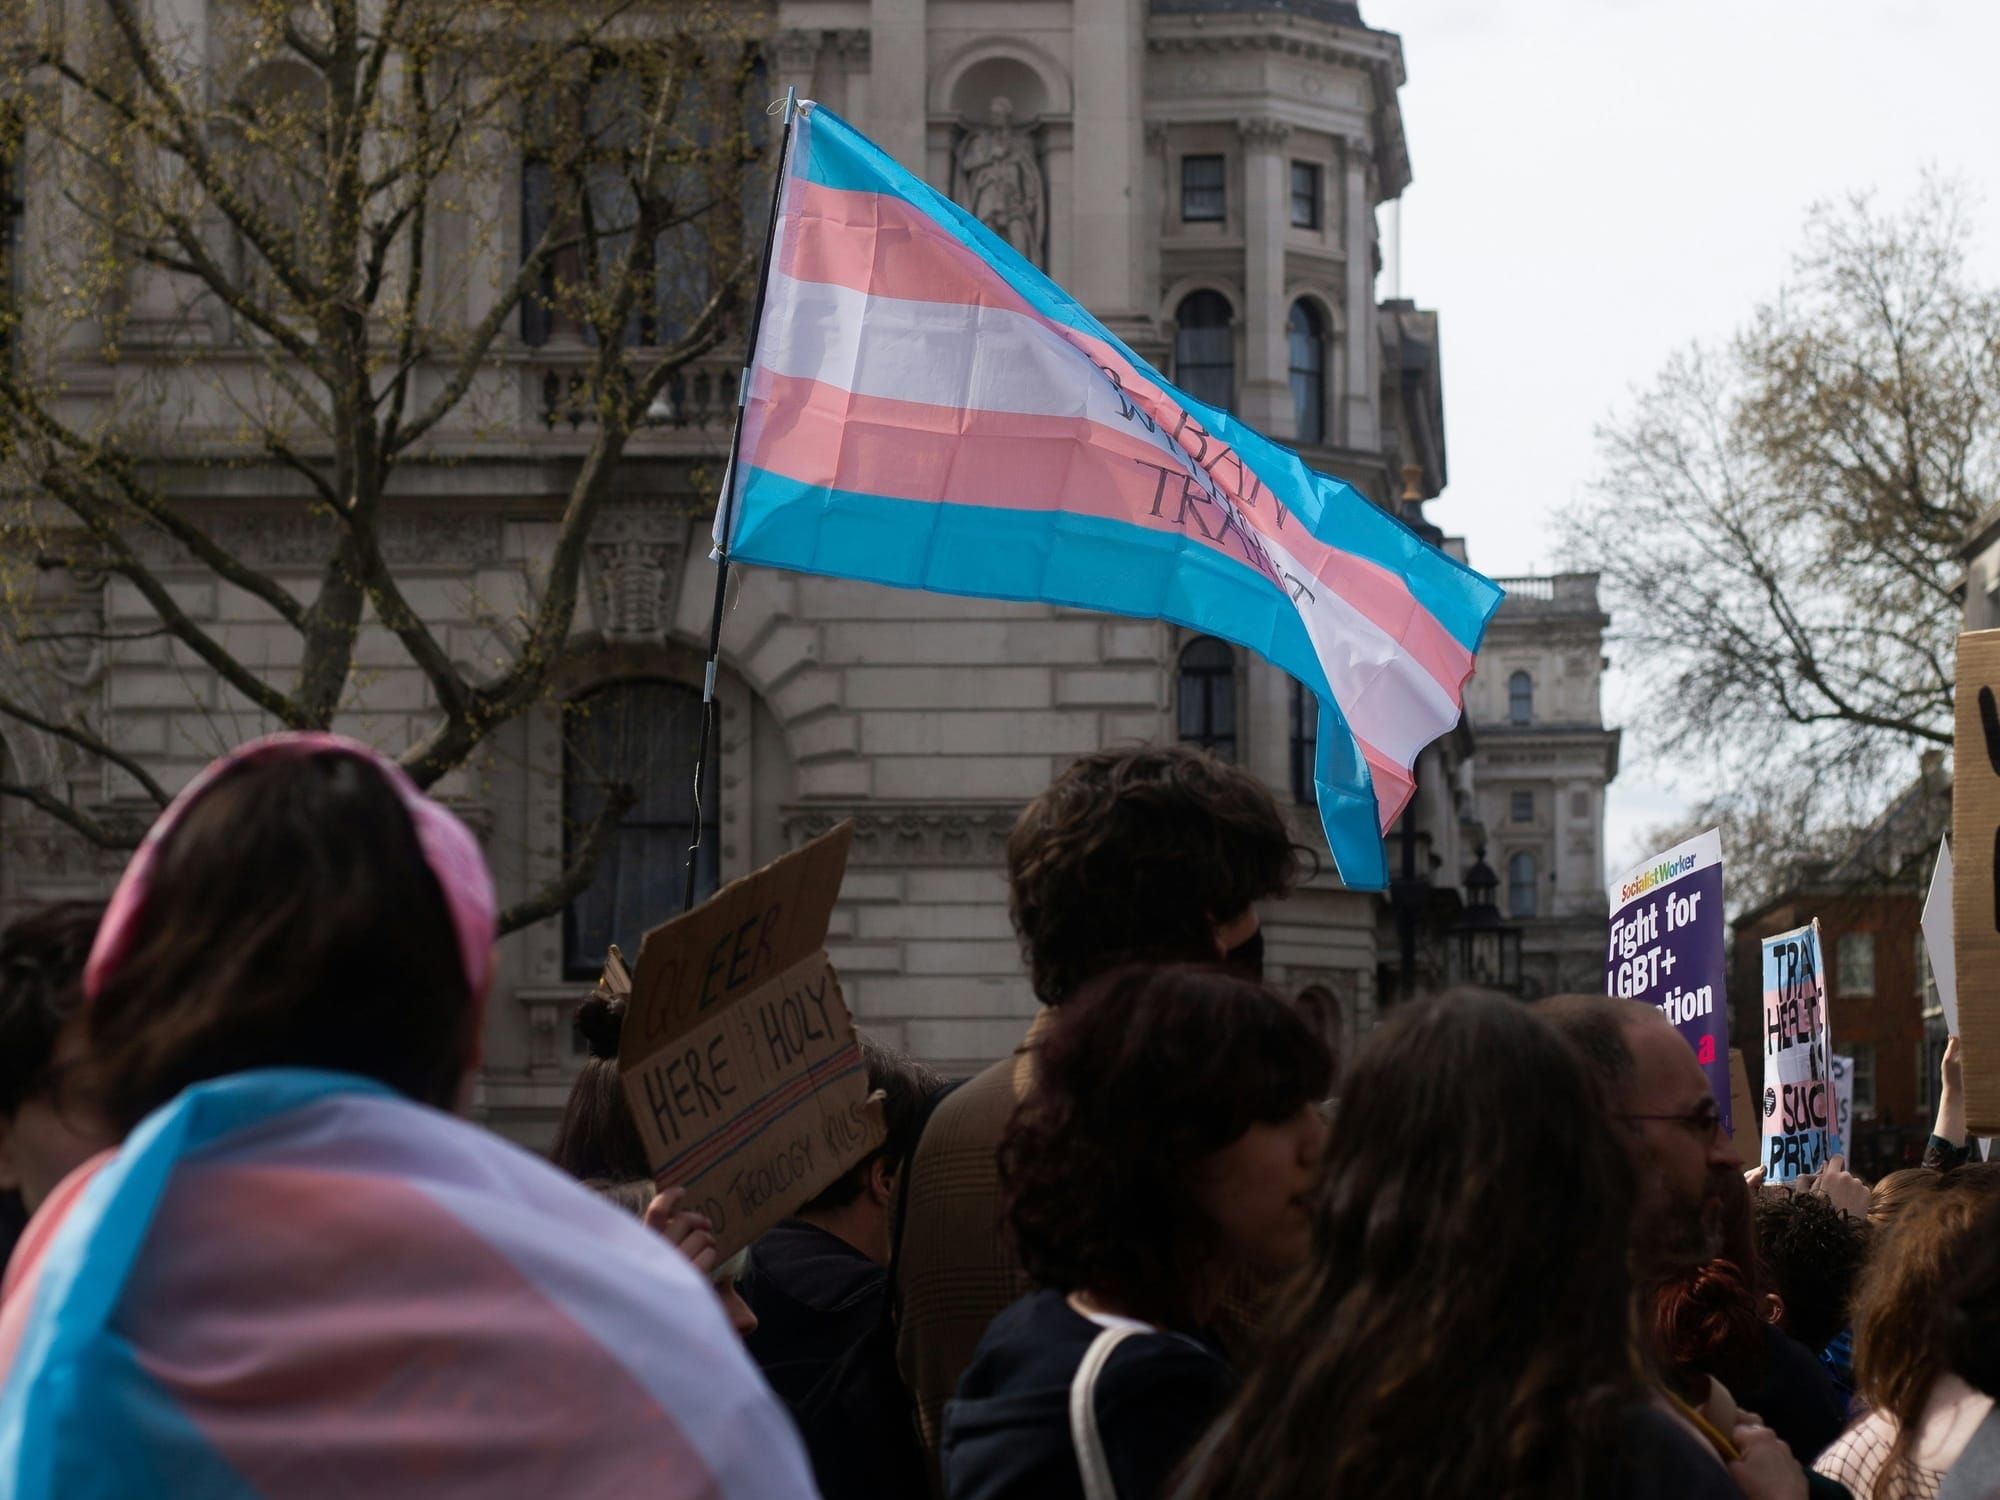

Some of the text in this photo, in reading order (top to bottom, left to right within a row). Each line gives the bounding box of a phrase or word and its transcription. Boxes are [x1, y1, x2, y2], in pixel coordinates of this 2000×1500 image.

[1621, 852, 1697, 903] Socialist Worker
[1608, 891, 1702, 962] Fight for
[651, 903, 783, 1041] QUEER
[1773, 937, 1822, 1003] TRA
[1656, 984, 1713, 1026] tion
[1768, 996, 1822, 1055] HEALT
[643, 1033, 737, 1147] HERE
[759, 975, 835, 1070] HOLY
[727, 1134, 815, 1218] THEOLOGY
[1769, 1131, 1829, 1179] PREV
